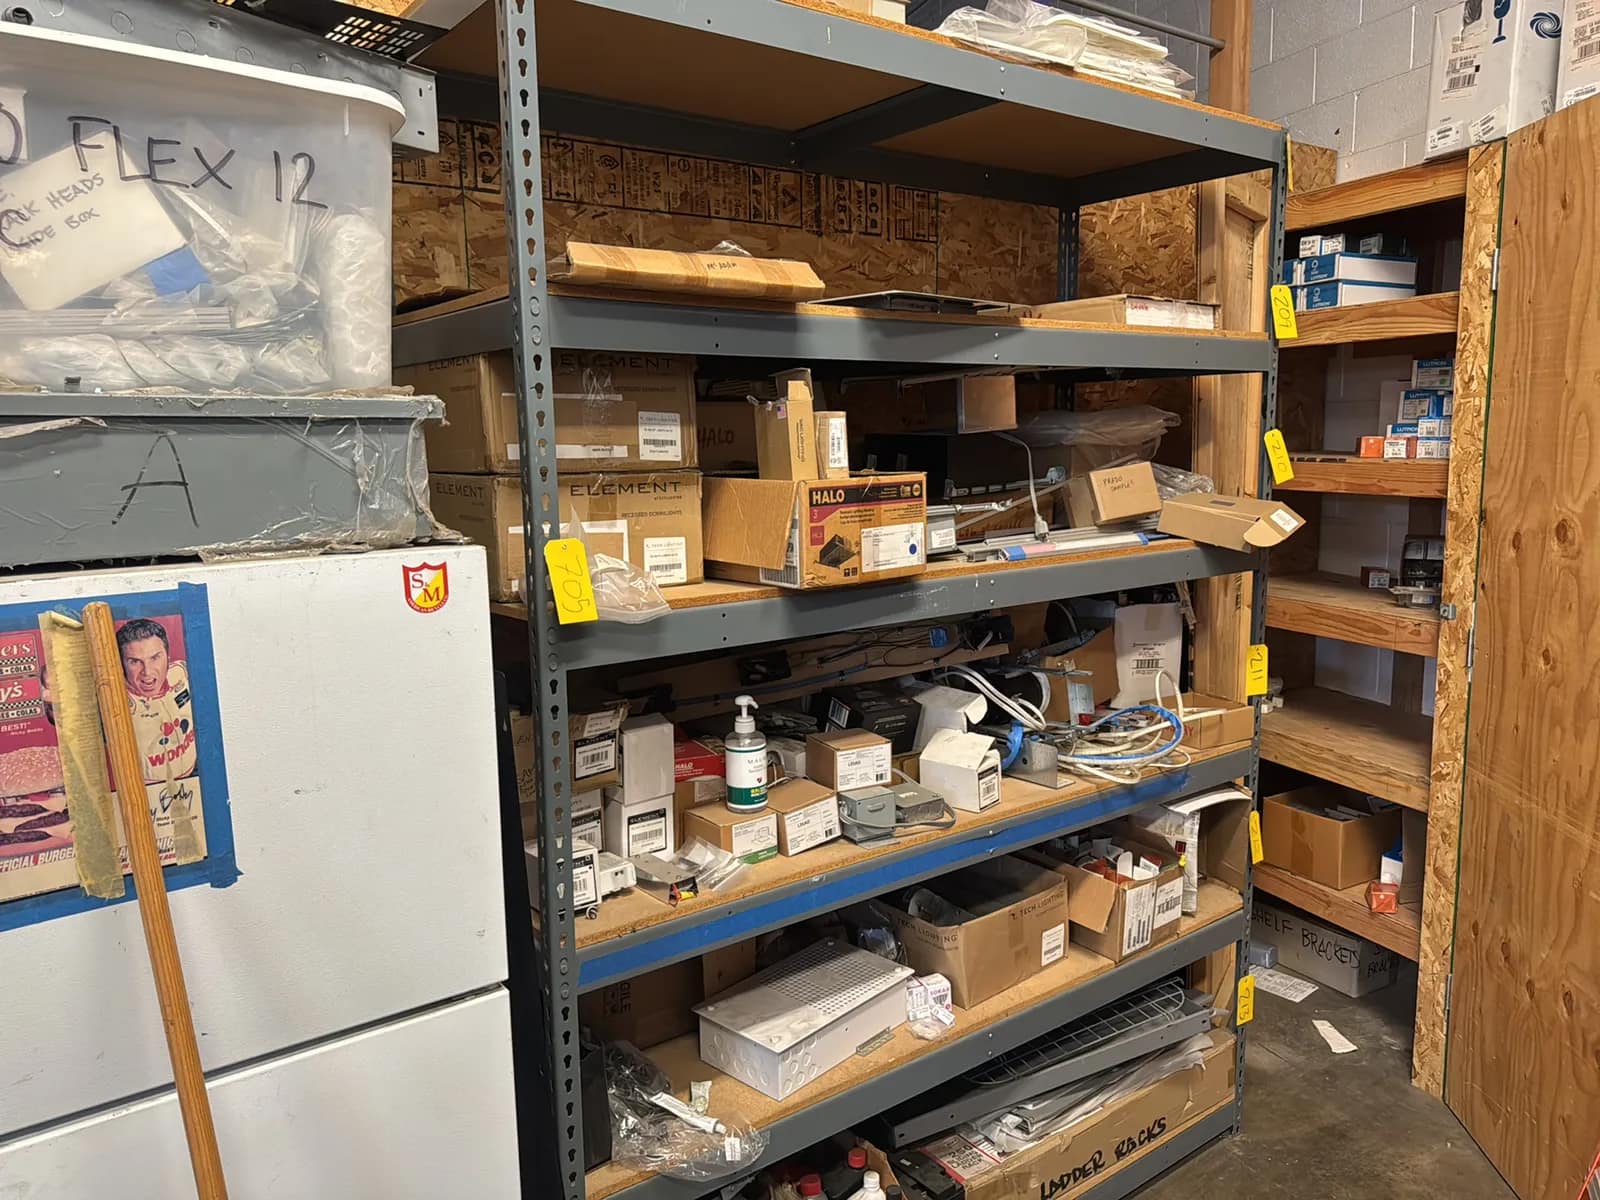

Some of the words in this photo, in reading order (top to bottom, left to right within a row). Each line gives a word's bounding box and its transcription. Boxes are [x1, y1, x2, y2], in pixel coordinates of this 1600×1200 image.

[67, 115, 236, 190] FLEX
[273, 149, 330, 209] 12
[46, 172, 105, 209] HEADS
[64, 208, 101, 229] BOX
[559, 353, 673, 369] ELEMENT
[111, 433, 200, 527] A
[436, 482, 484, 498] ELEMENT
[569, 481, 682, 497] ELEMENT
[812, 489, 845, 505] HALO
[1019, 905, 1038, 917] TECH
[1301, 927, 1361, 969] BRACKETS
[1040, 1150, 1106, 1200] LADDER
[1114, 1116, 1167, 1161] RACKS
